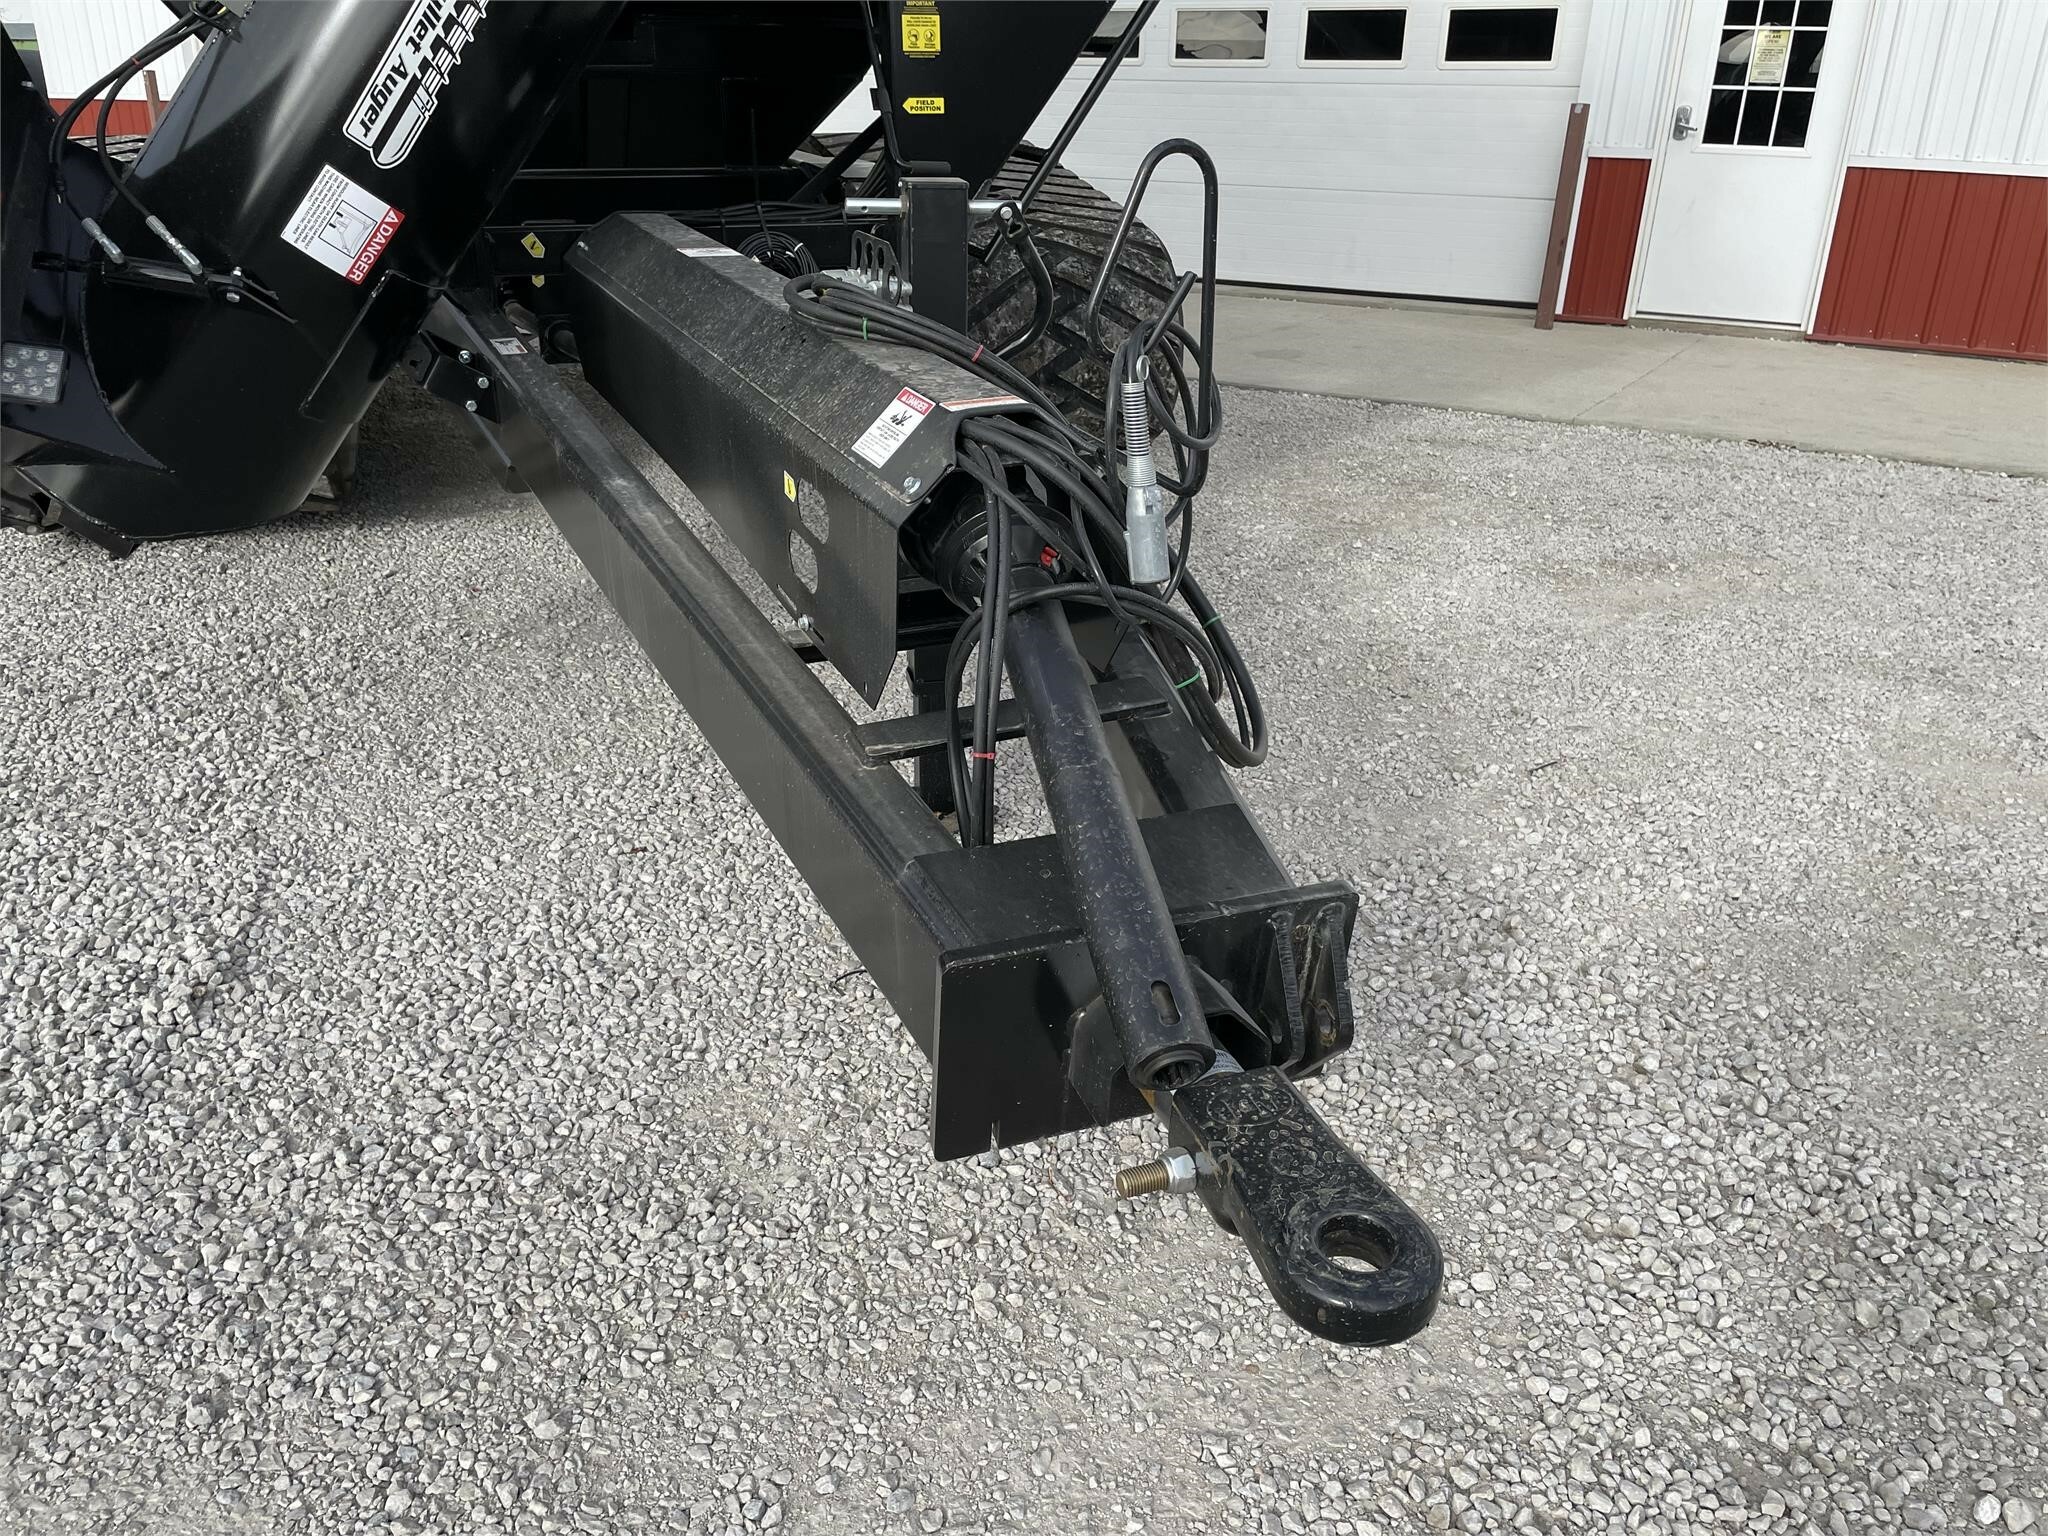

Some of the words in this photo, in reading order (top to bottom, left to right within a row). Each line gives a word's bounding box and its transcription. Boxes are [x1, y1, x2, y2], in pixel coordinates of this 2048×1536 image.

[359, 53, 407, 137] Auger
[348, 222, 393, 282] DANGER
[904, 394, 928, 412] DANGER
